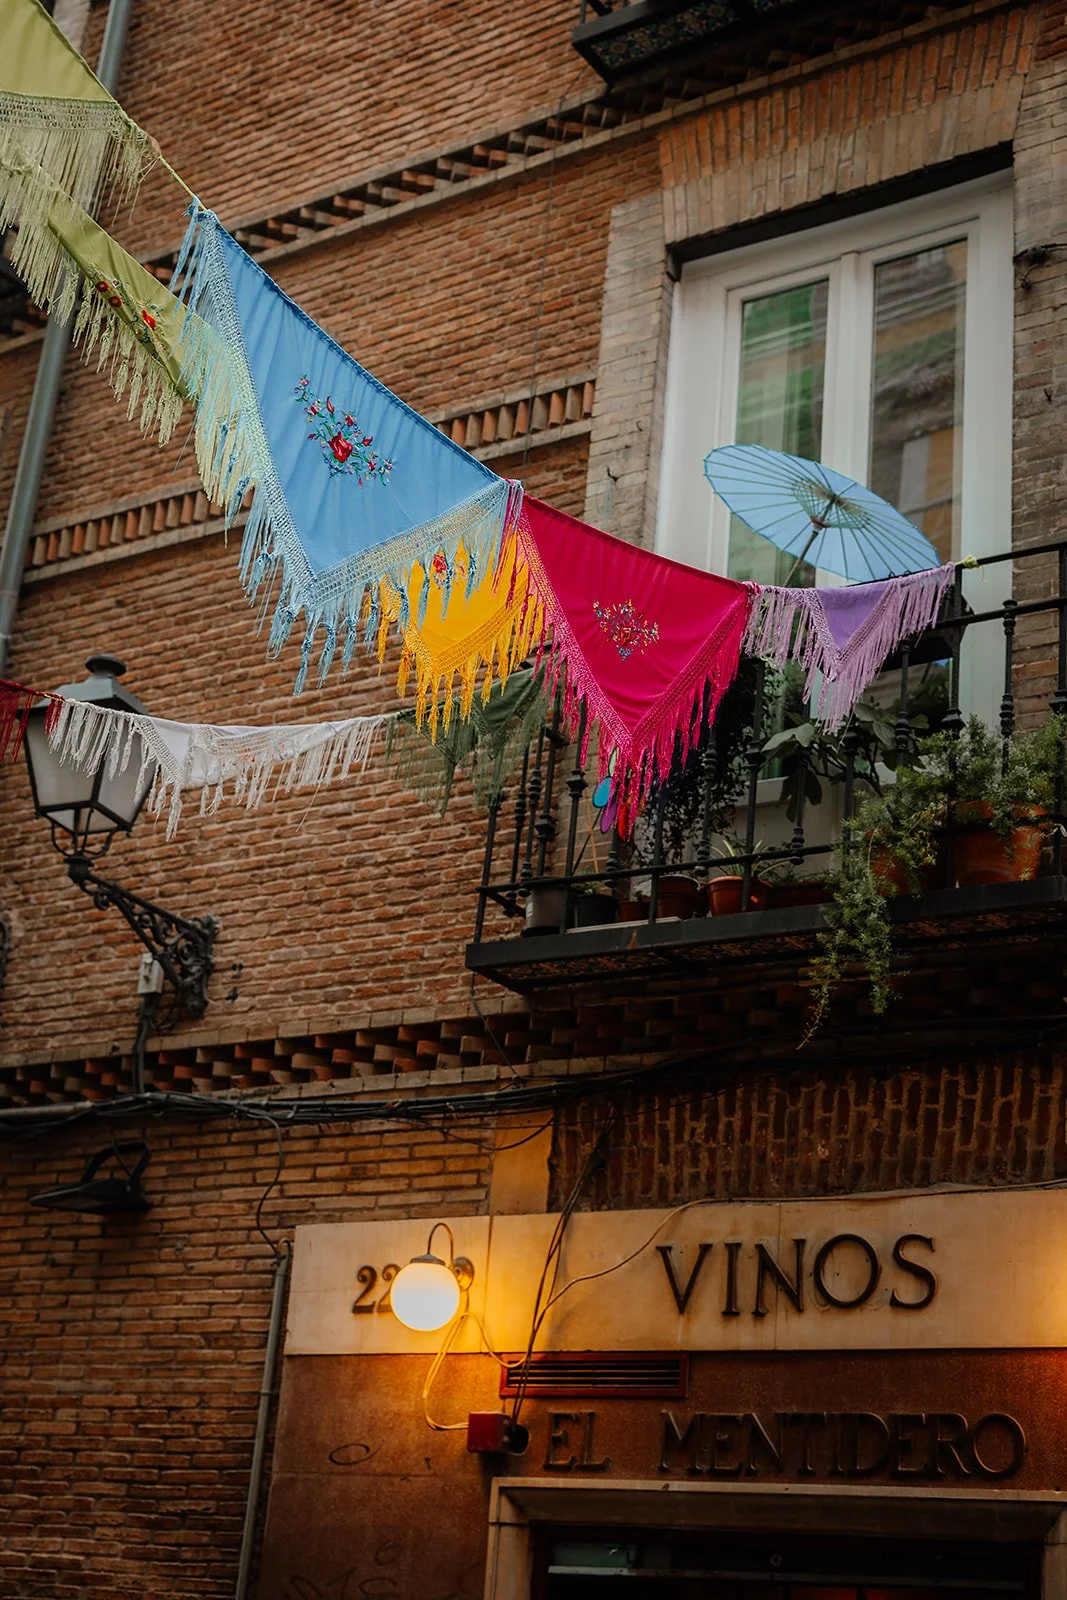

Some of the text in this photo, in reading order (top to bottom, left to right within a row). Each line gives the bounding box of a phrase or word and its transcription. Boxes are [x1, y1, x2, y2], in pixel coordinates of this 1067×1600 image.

[656, 1233, 937, 1317] VINOS
[543, 1410, 1027, 1480] EL MENTIDERO
